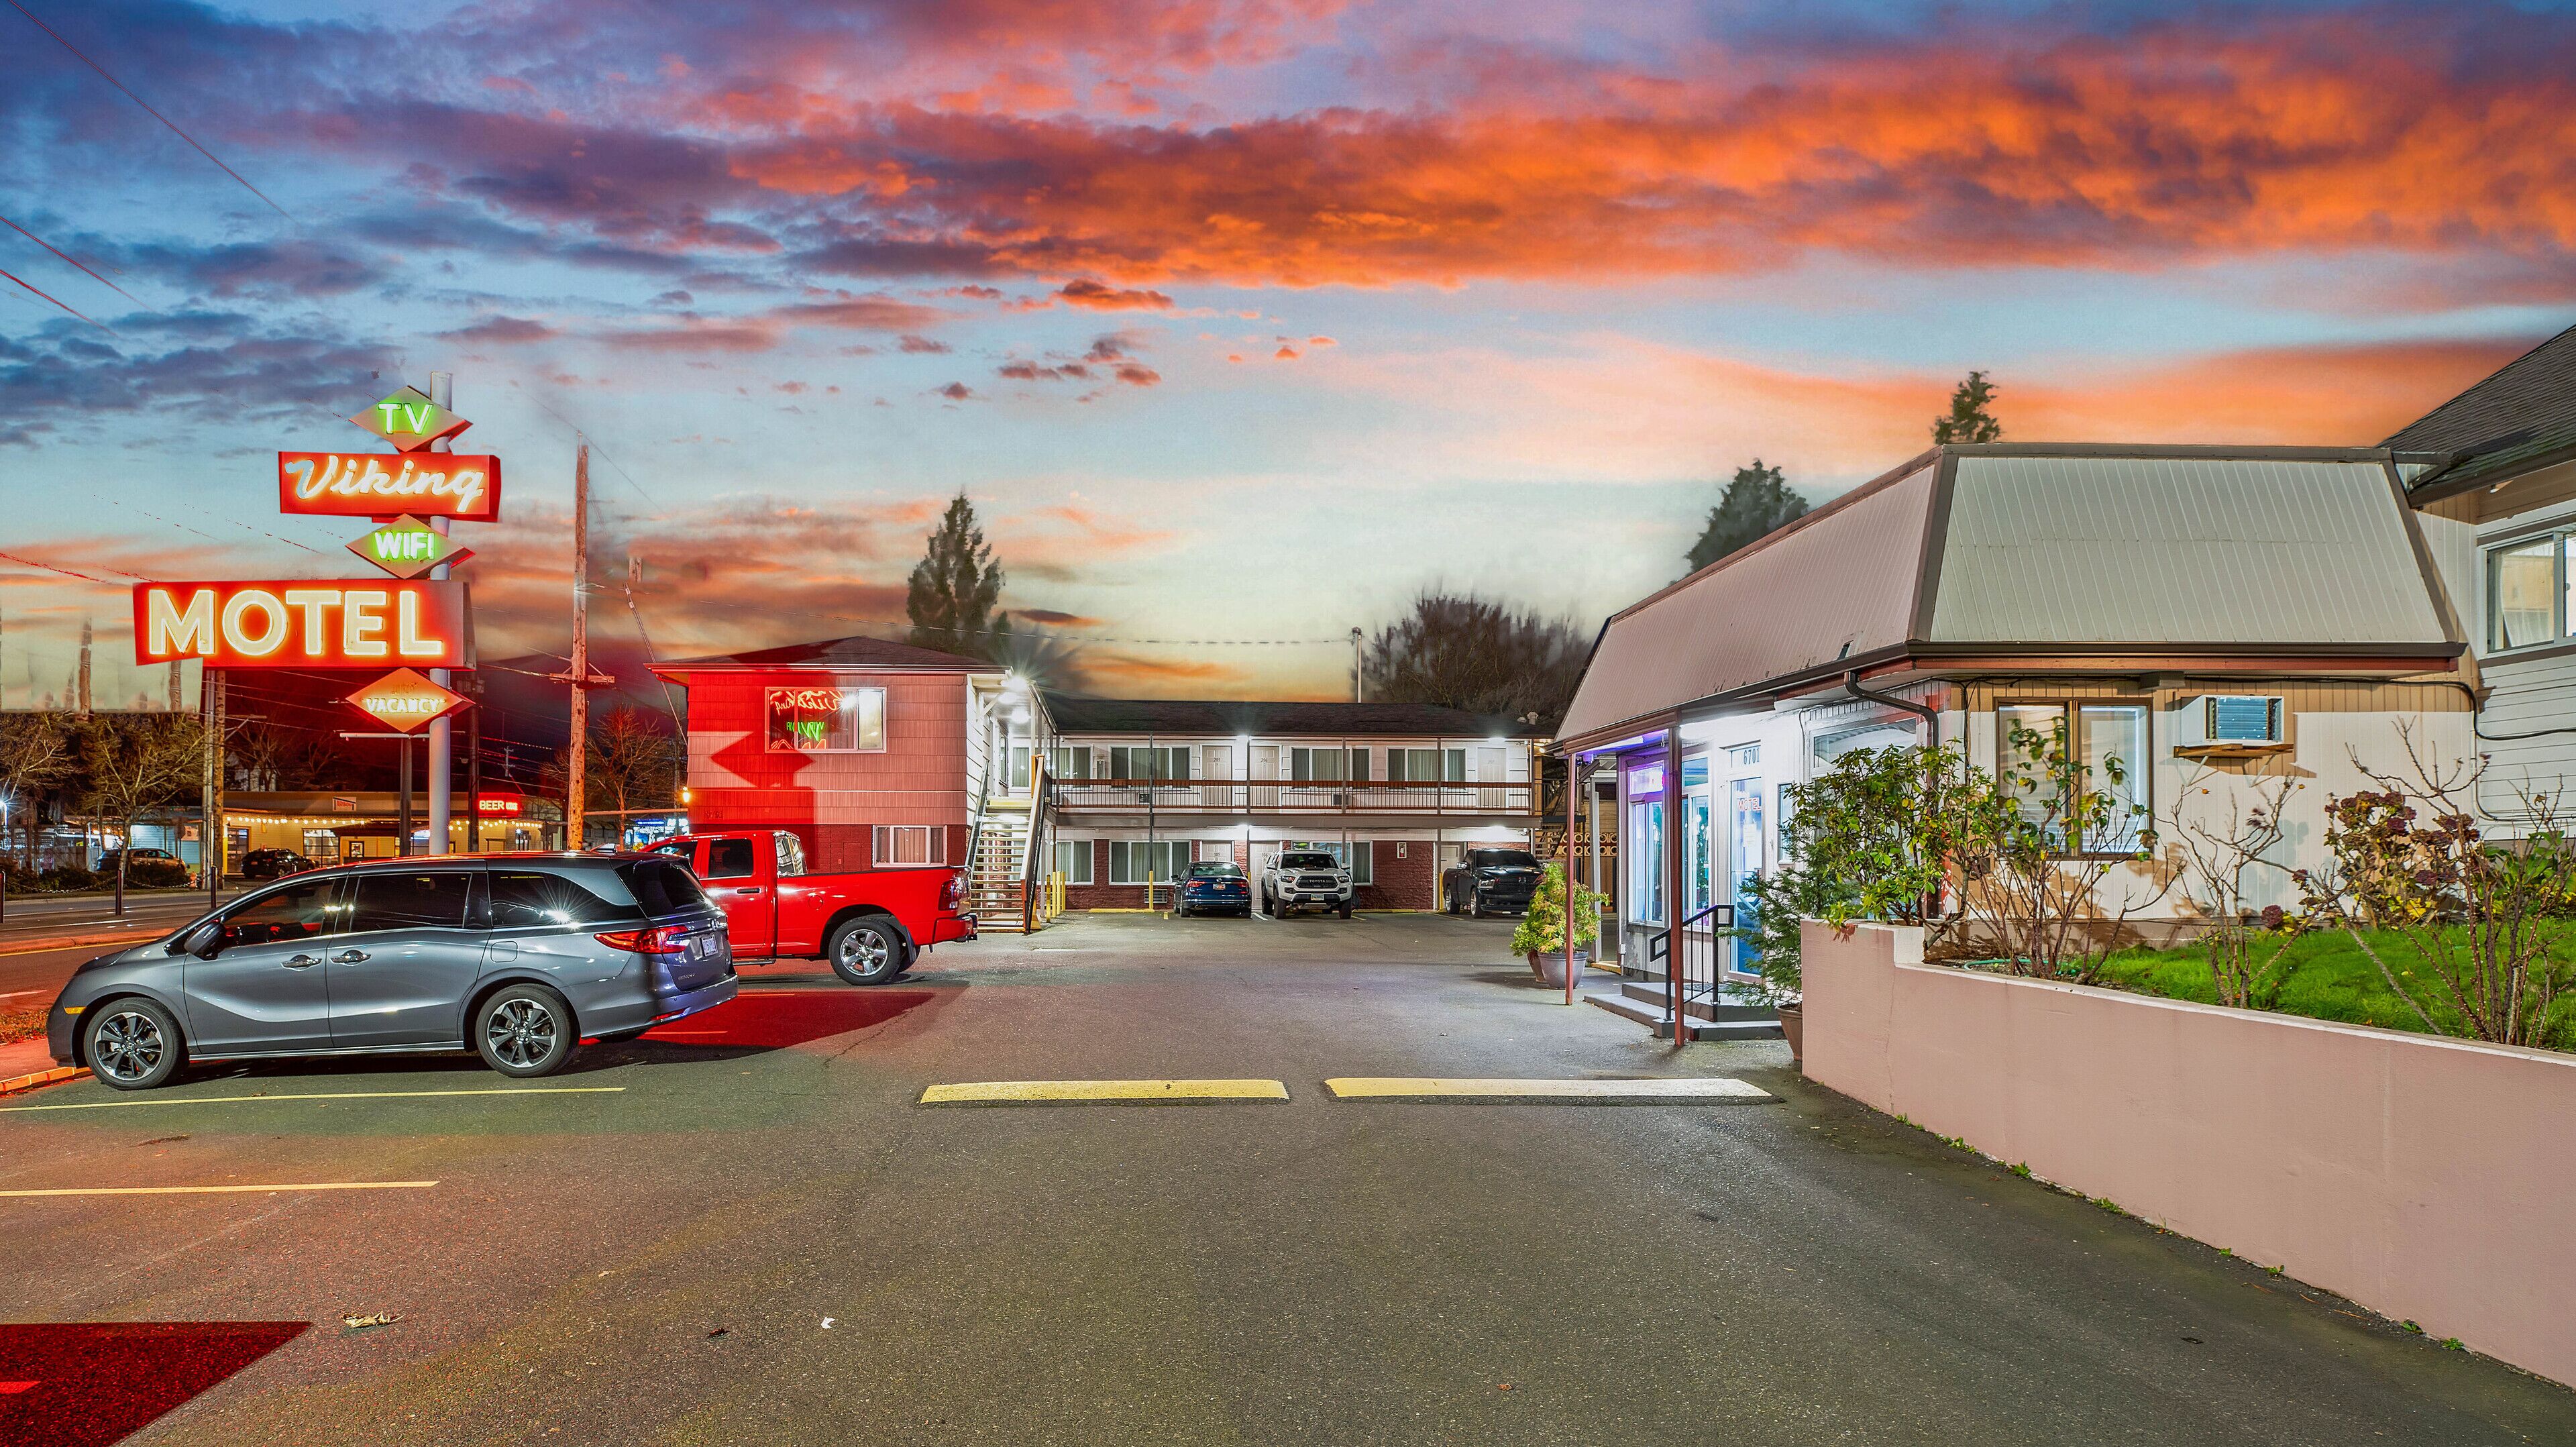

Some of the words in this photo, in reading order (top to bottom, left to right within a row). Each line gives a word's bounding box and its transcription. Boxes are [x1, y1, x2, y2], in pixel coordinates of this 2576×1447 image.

[378, 403, 433, 435] TV
[285, 455, 484, 513] Viking
[374, 531, 435, 559] WIFI
[148, 588, 443, 655] MOTEL
[365, 698, 440, 713] VACANCY
[1743, 747, 1760, 765] 6701
[479, 800, 505, 810] BEER
[1738, 797, 1762, 811] MOTEL
